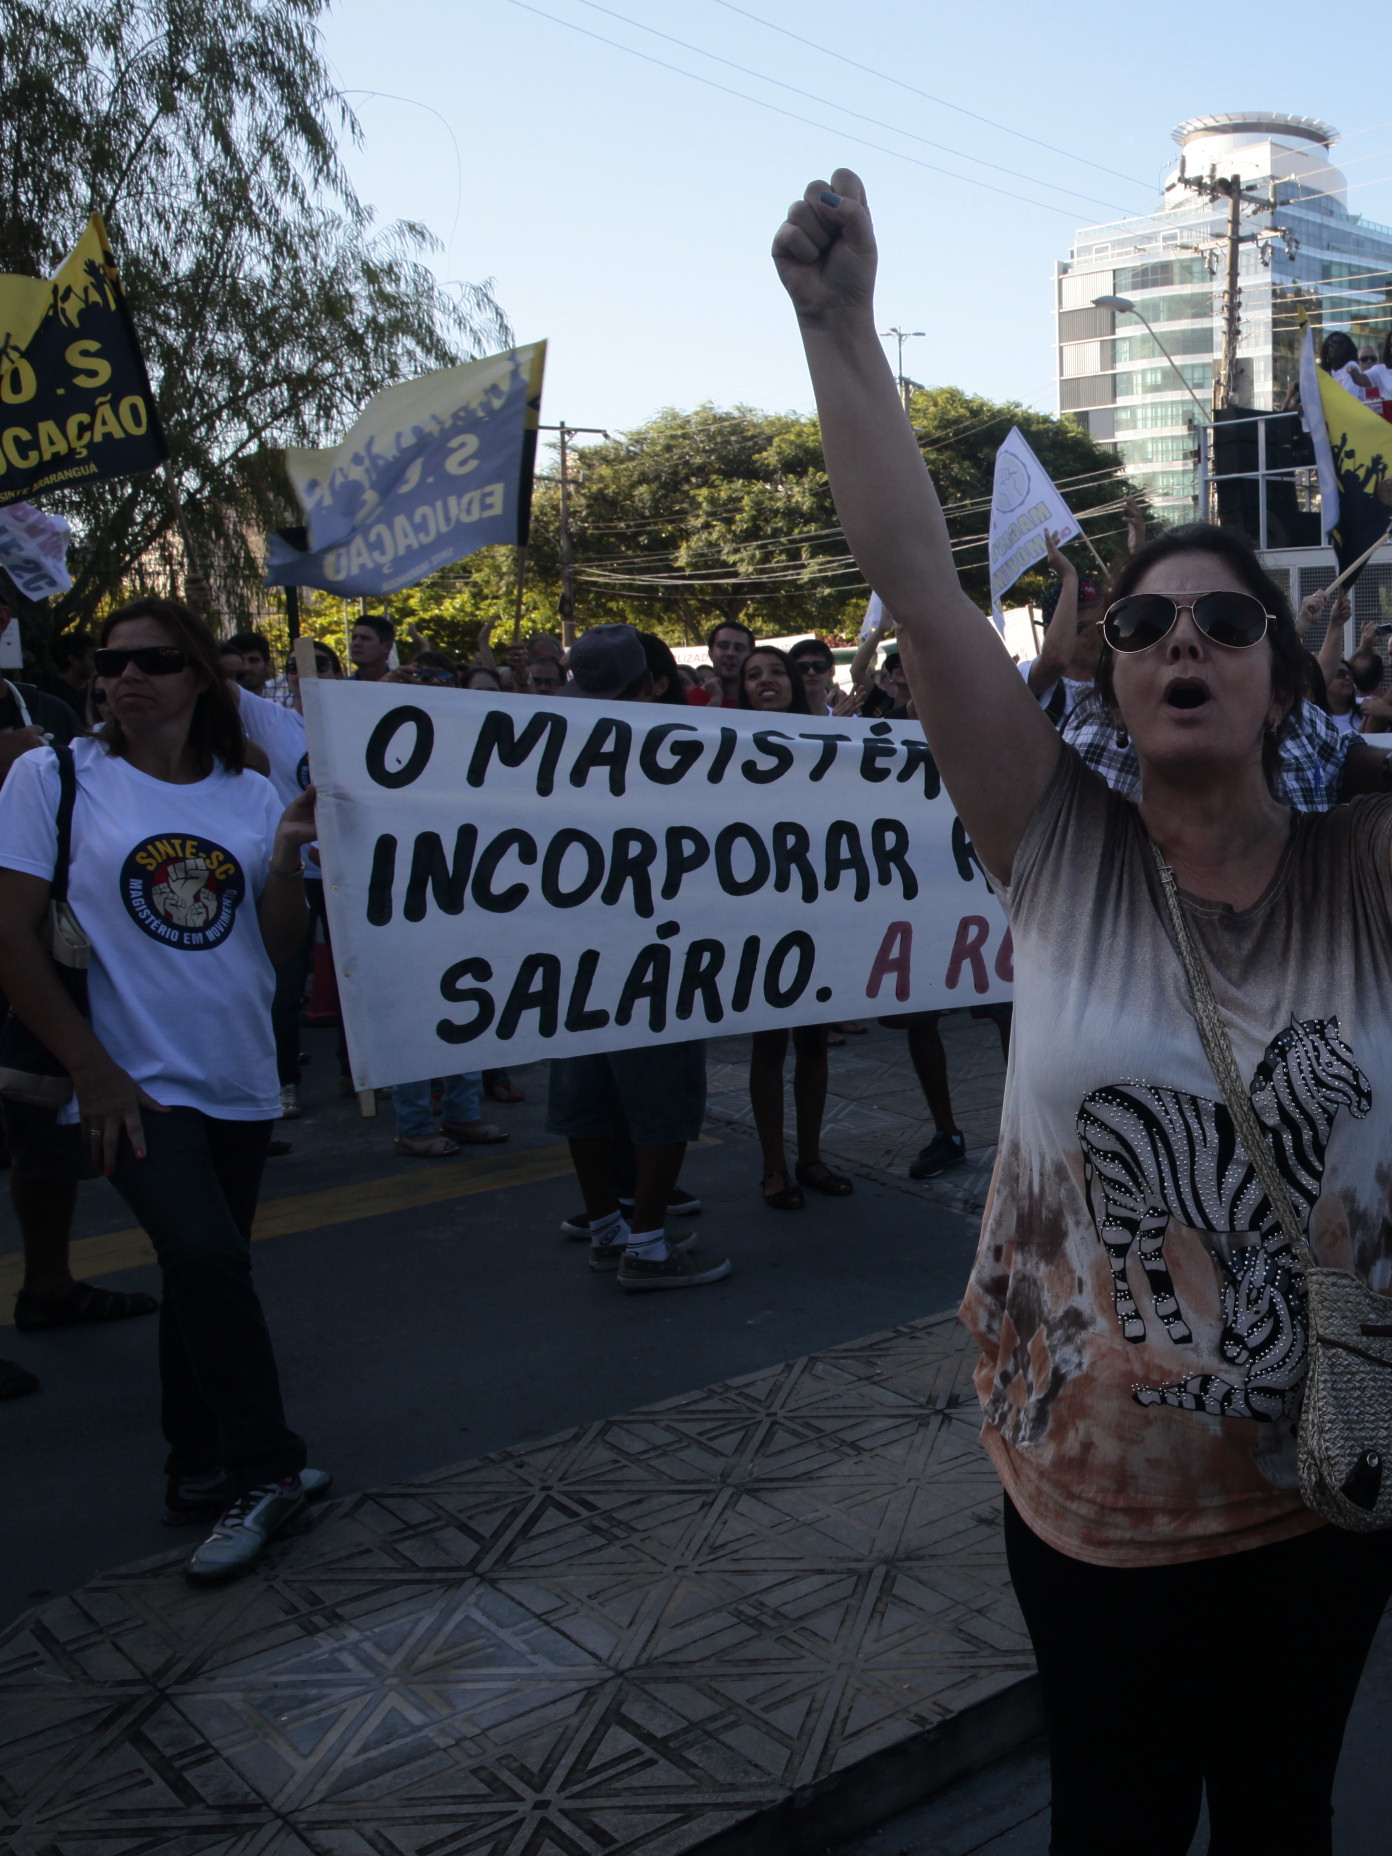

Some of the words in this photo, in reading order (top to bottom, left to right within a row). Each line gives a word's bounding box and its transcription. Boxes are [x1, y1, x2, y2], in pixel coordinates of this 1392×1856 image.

[33, 461, 99, 493] ARARANGUÁ
[366, 704, 434, 789] O
[135, 838, 236, 880] SINTE-SC
[367, 817, 918, 926] INCORPORAR
[128, 878, 179, 942] MAGISTÉRIO
[183, 932, 204, 945] EM
[205, 889, 238, 943] MOVIMENTO
[436, 920, 833, 1044] SALÁRIO.
[866, 920, 912, 1002] A
